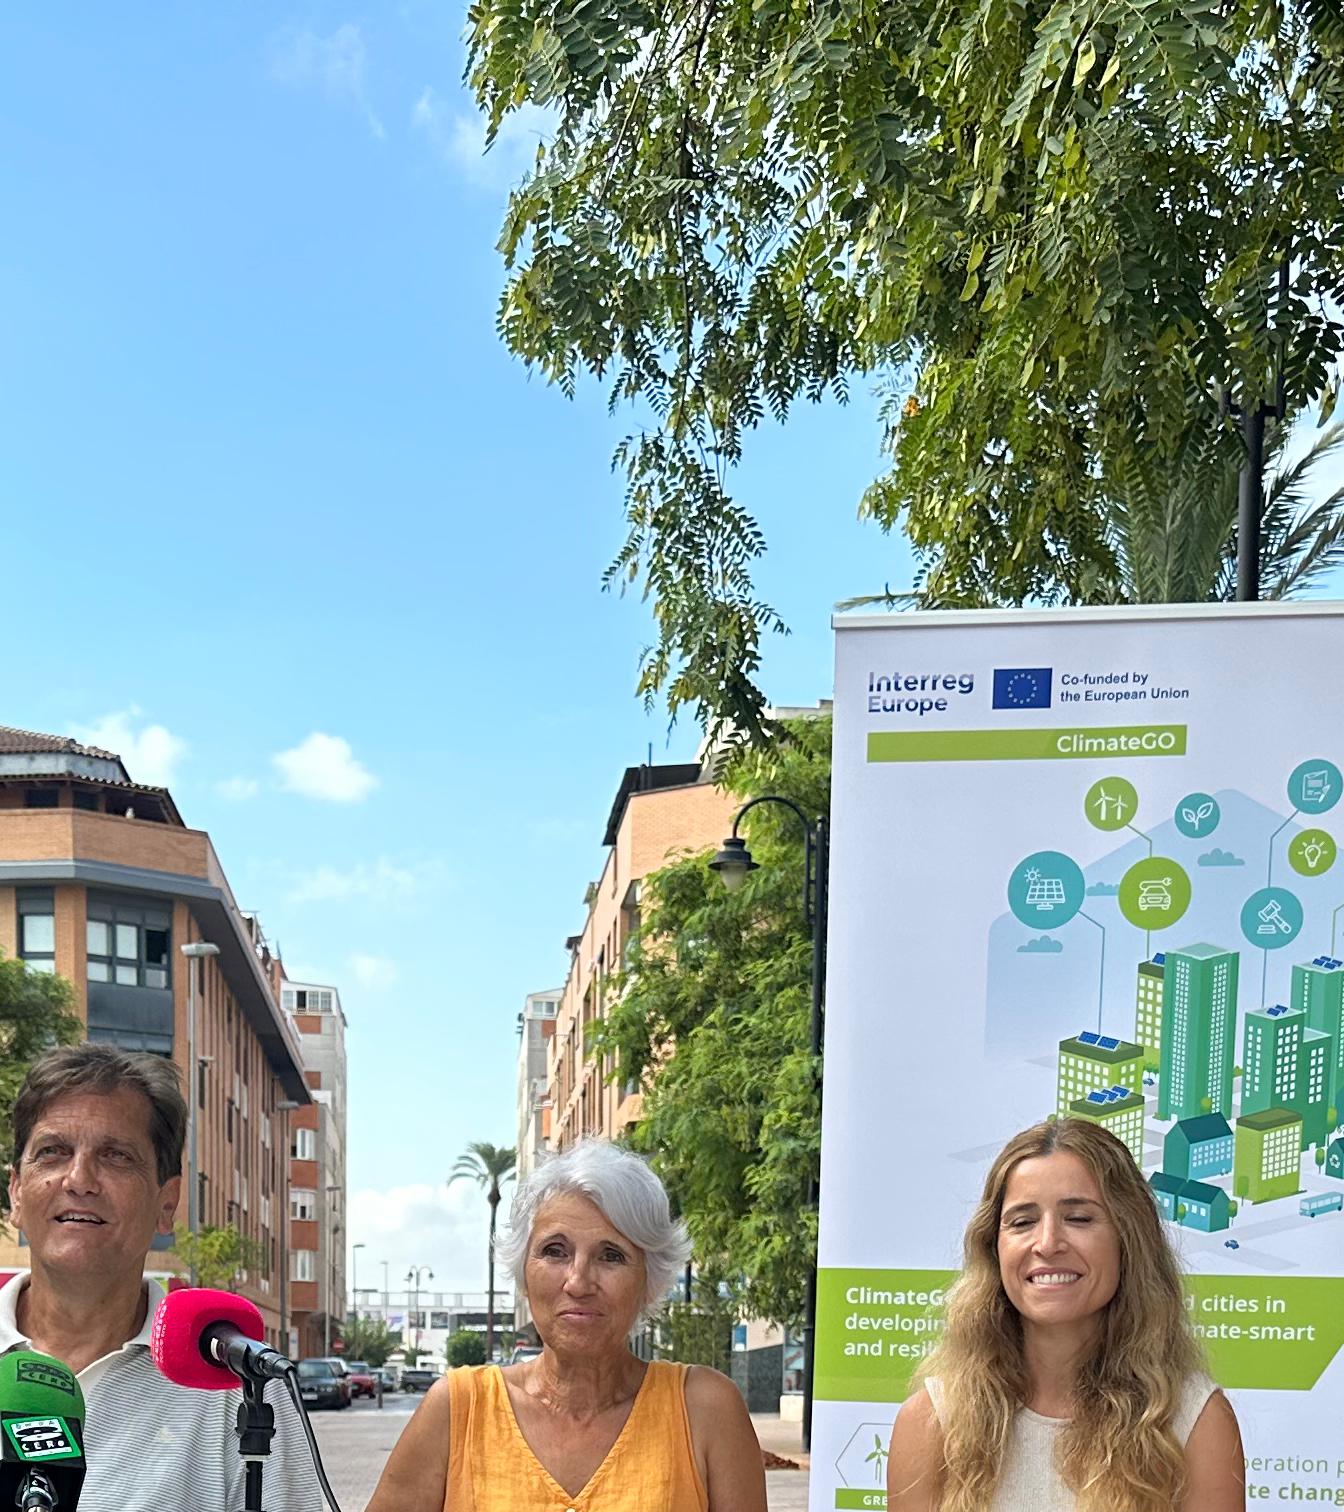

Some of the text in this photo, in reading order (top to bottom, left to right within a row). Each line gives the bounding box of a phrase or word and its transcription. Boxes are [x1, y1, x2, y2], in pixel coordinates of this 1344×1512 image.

[868, 671, 975, 694] Interreg
[1061, 672, 1149, 687] Co-funded by
[1060, 687, 1189, 703] the European Union
[868, 695, 948, 716] Europe
[1056, 731, 1176, 753] ClimateGO
[845, 1287, 950, 1306] ClimateG
[1201, 1294, 1259, 1312] cities
[1265, 1295, 1286, 1313] in
[843, 1339, 883, 1356] and
[21, 1440, 65, 1451] CERO
